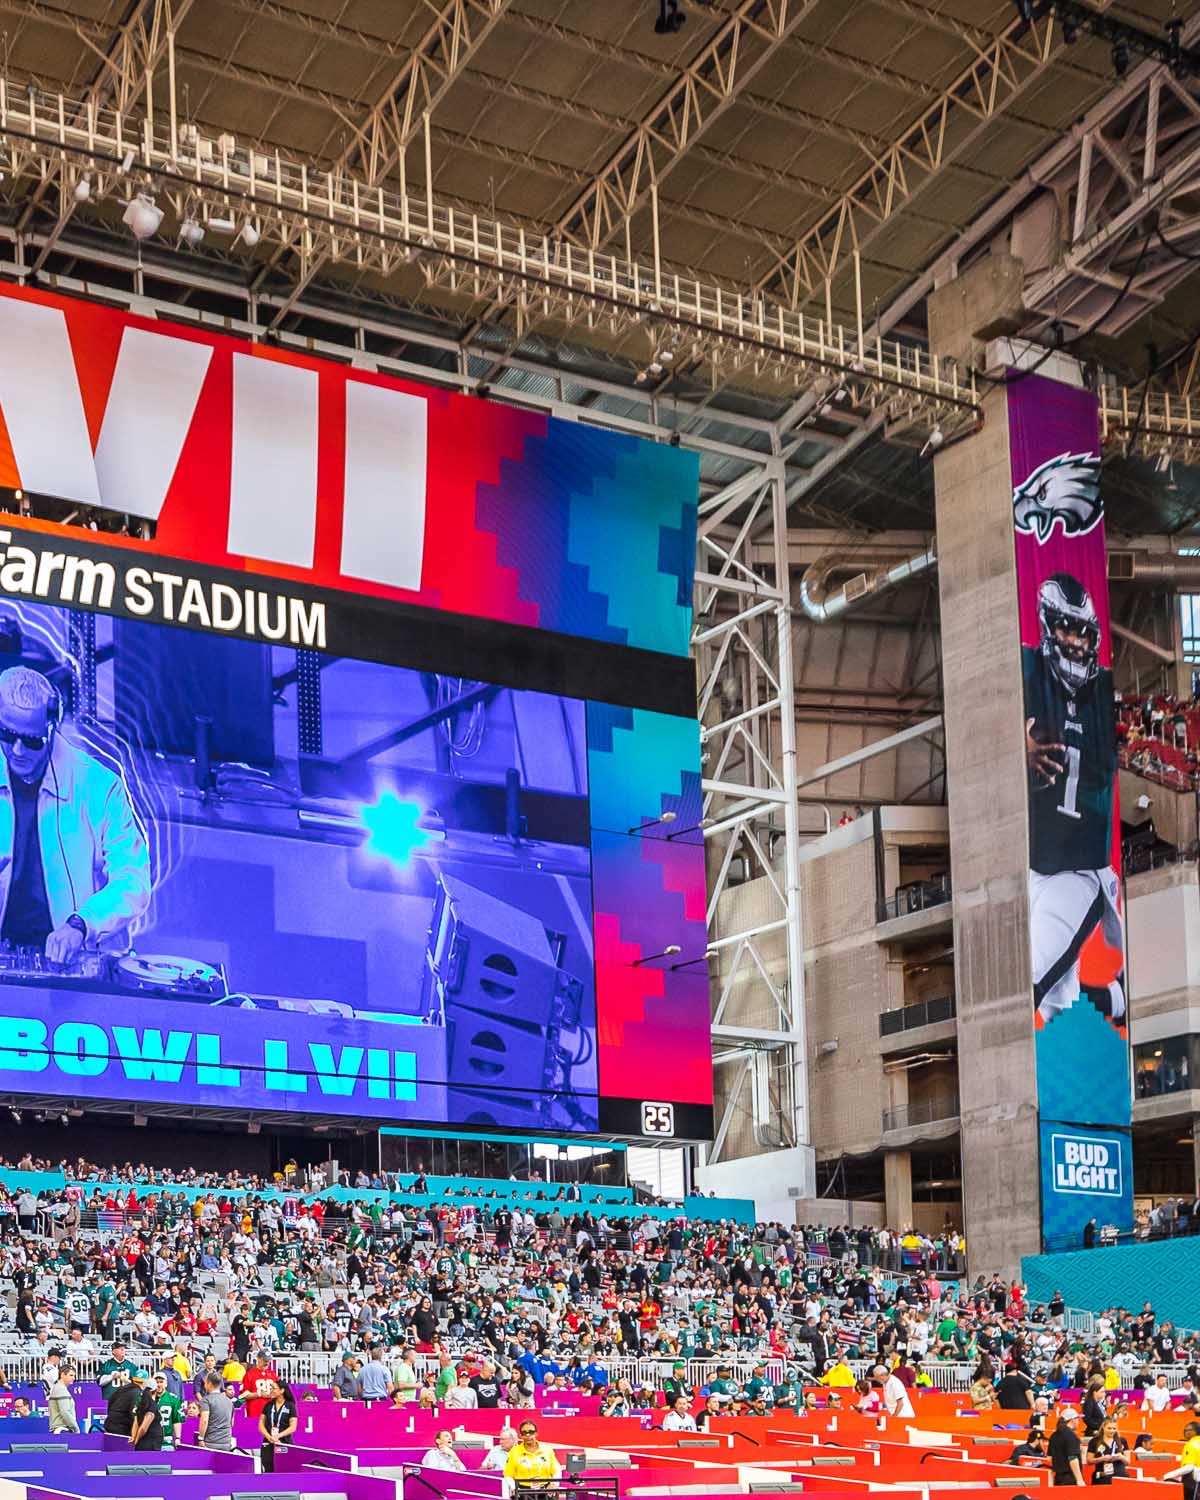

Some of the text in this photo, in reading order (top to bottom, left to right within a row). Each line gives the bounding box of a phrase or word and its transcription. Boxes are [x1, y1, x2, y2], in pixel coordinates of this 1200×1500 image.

[123, 567, 327, 649] STADIUM
[264, 1040, 418, 1102] LVII
[645, 1106, 671, 1132] 25
[1064, 1142, 1109, 1167] BUD
[1057, 1164, 1118, 1190] LIGHT
[72, 1300, 89, 1313] 99
